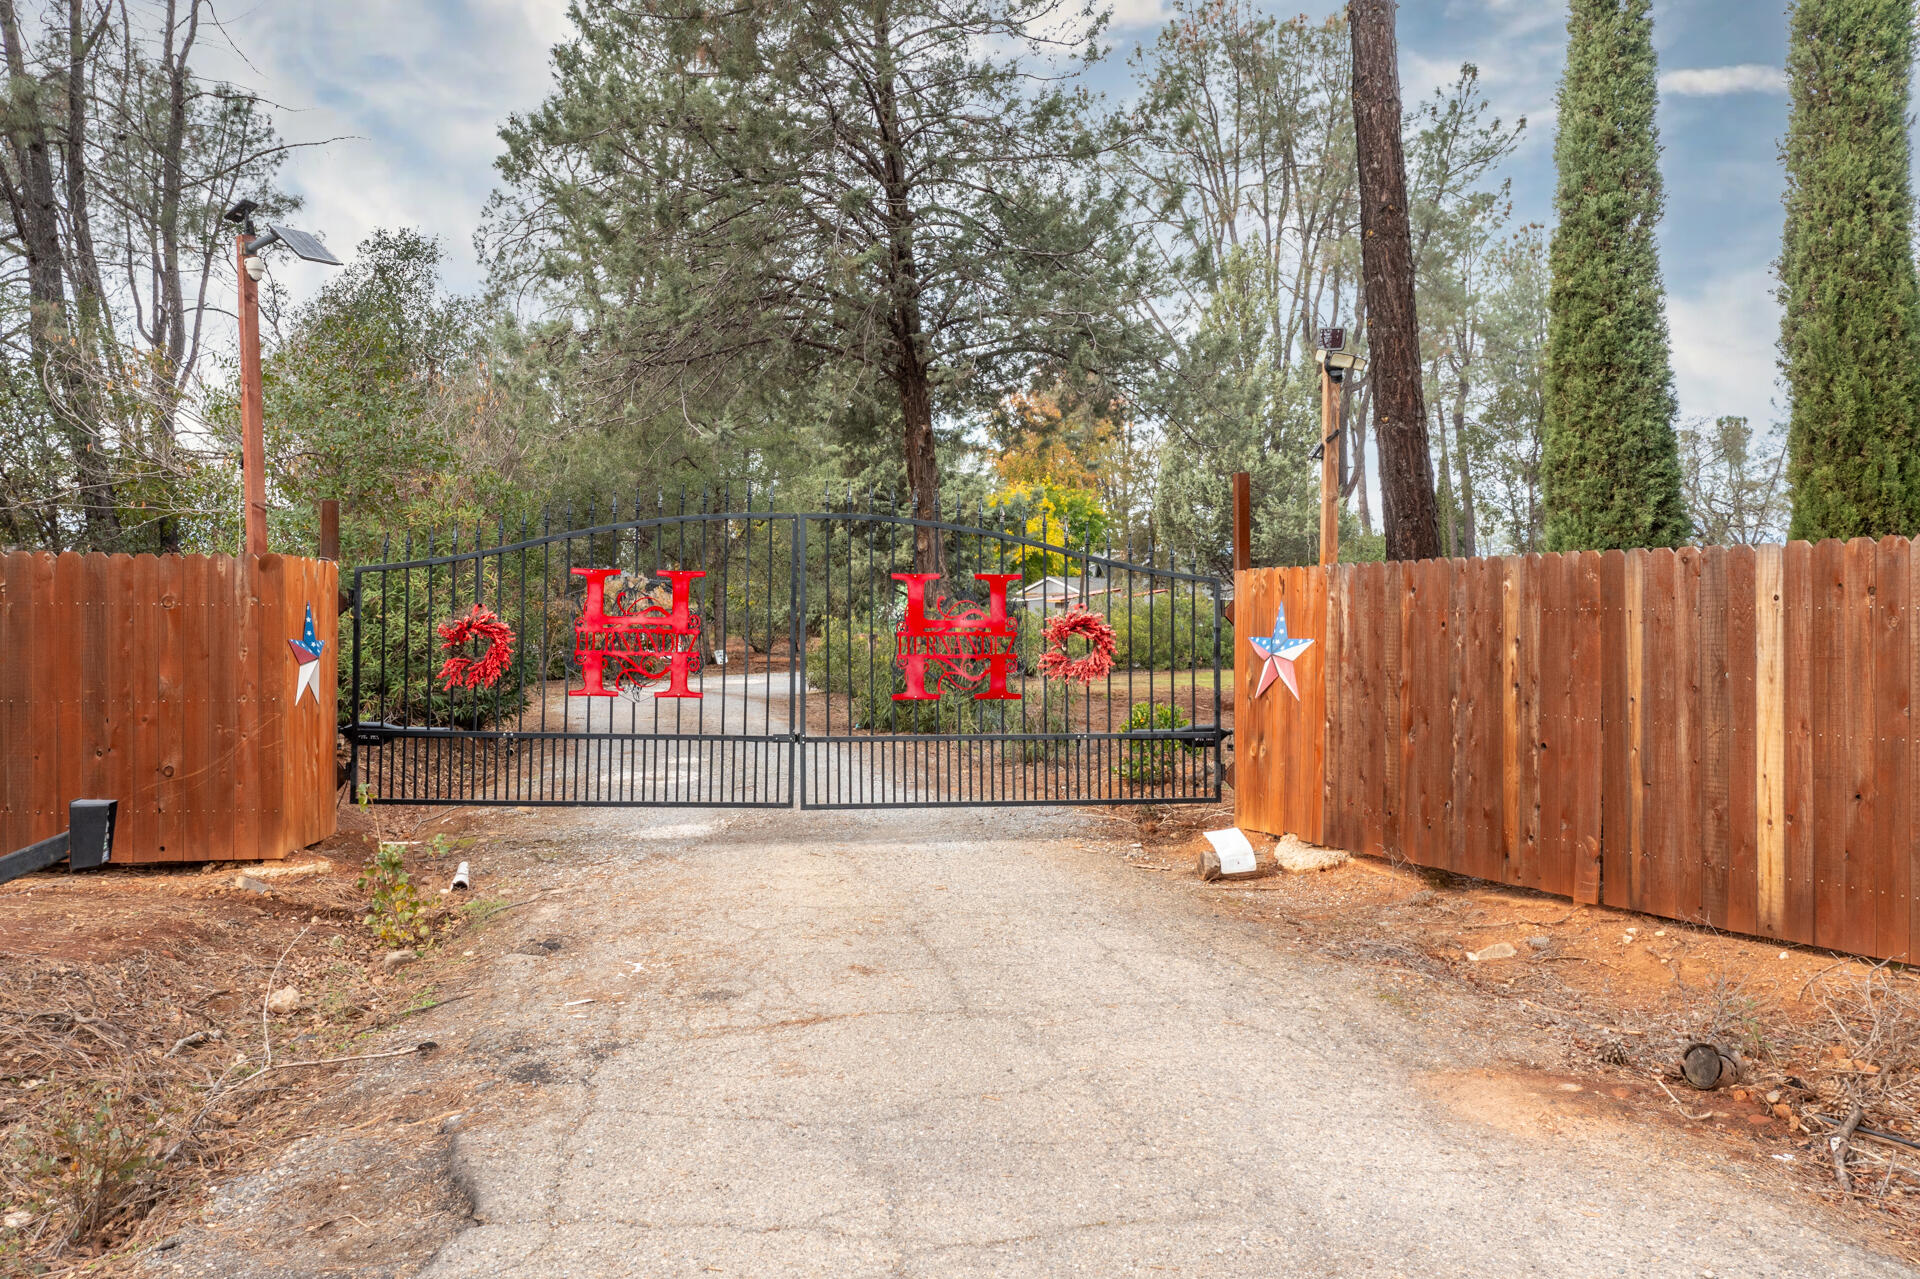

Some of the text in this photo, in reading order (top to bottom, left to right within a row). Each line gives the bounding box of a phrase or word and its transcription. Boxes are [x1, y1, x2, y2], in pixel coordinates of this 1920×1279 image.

[569, 568, 706, 699] H
[576, 631, 699, 654] HERNANDEZ
[891, 573, 1022, 700] H
[898, 634, 1016, 656] HERNANDEZ
